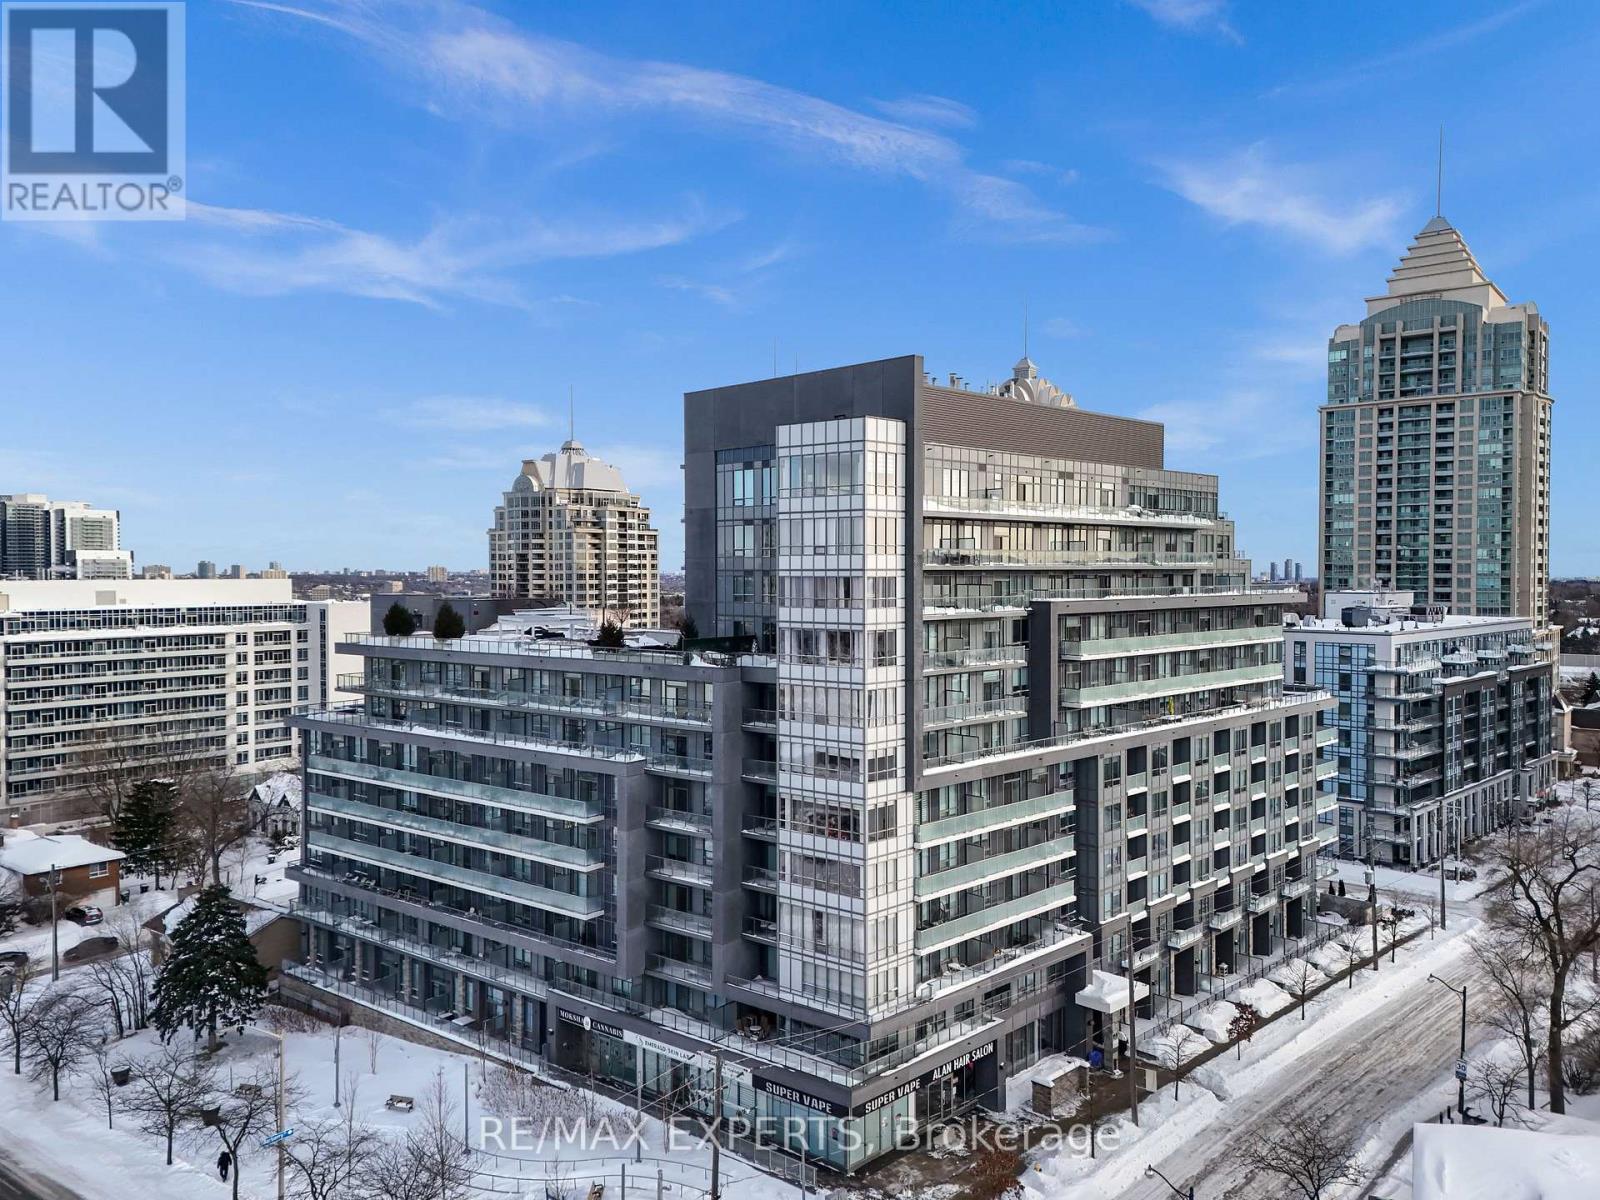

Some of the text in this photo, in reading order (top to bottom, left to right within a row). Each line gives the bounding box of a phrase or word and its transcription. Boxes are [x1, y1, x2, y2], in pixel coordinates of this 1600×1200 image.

[592, 1021, 623, 1038] CANNABIS
[645, 1040, 667, 1053] EMERALD
[933, 1042, 994, 1081] ALAN HAIR SALON
[765, 1081, 832, 1114] SUPER VAPE
[865, 1078, 920, 1114] SUPER VAPE
